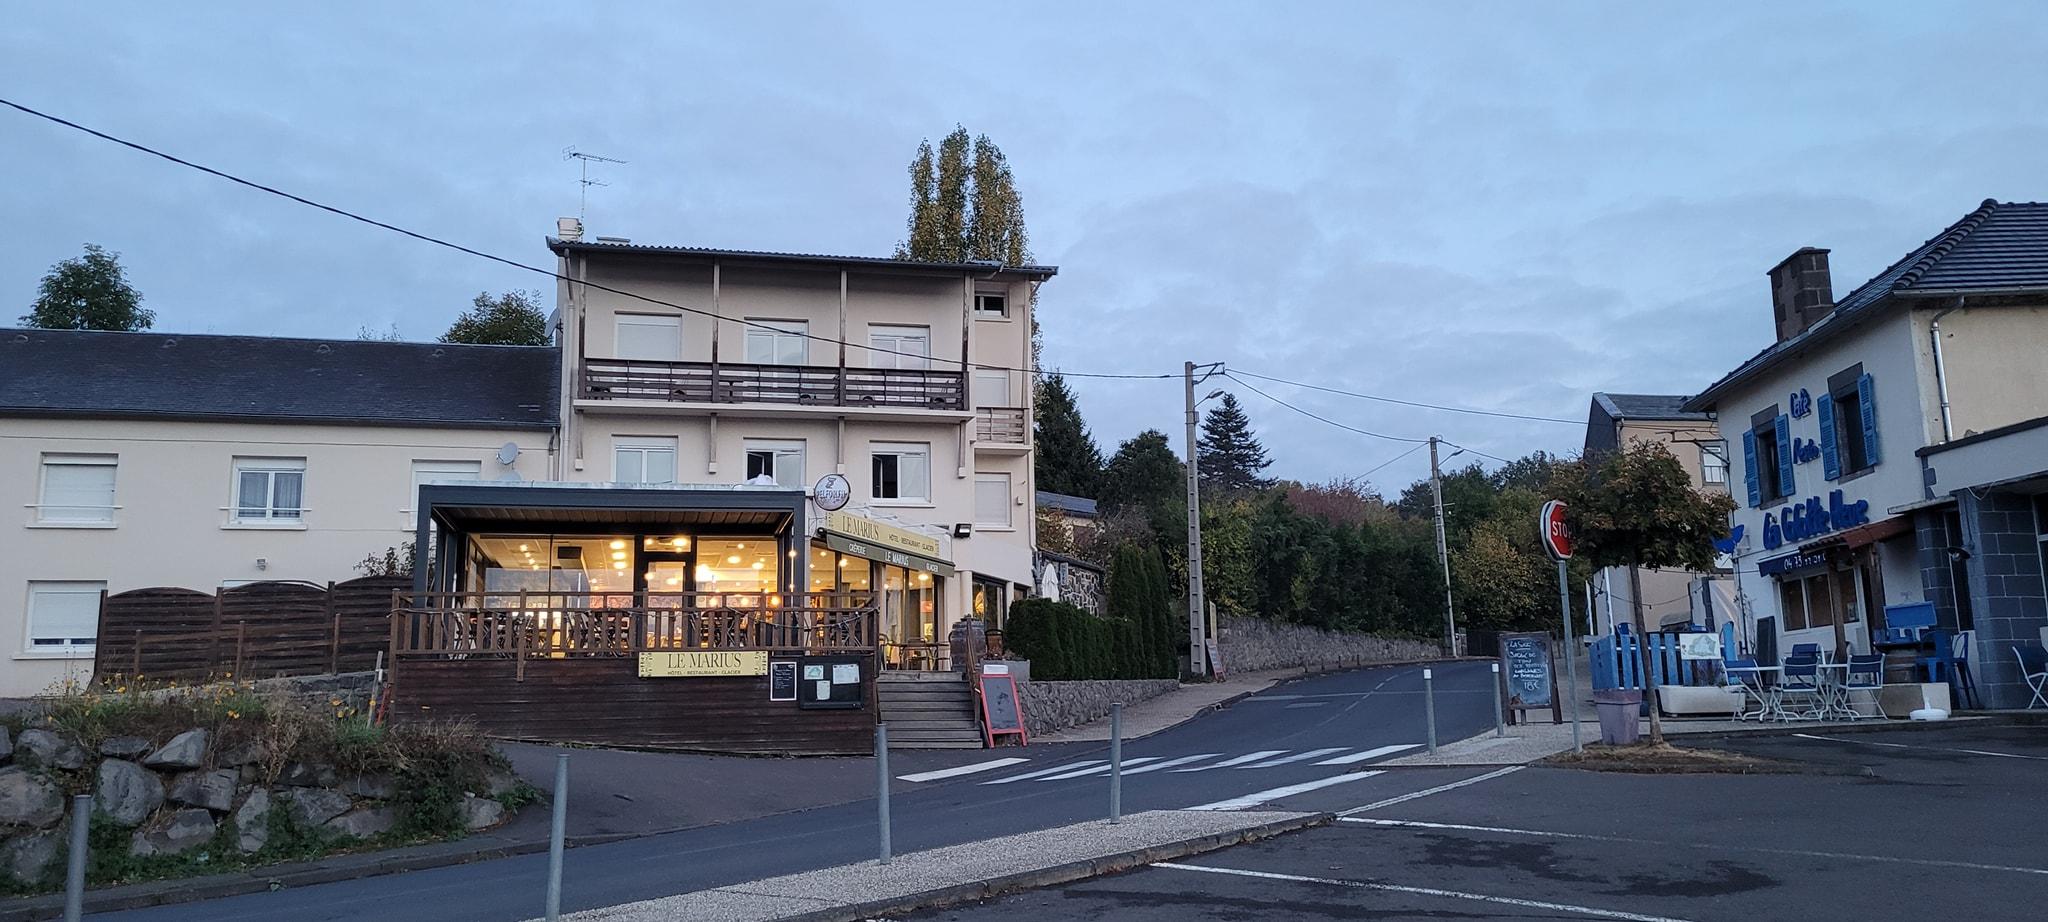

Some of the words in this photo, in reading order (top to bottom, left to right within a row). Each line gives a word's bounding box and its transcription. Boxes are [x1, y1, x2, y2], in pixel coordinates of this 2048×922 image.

[842, 516, 851, 533] LE
[853, 519, 879, 540] MARIUS
[885, 552, 891, 562] LE
[892, 553, 909, 566] MARIUS
[668, 653, 685, 668] LE
[689, 653, 741, 668] MARIUS
